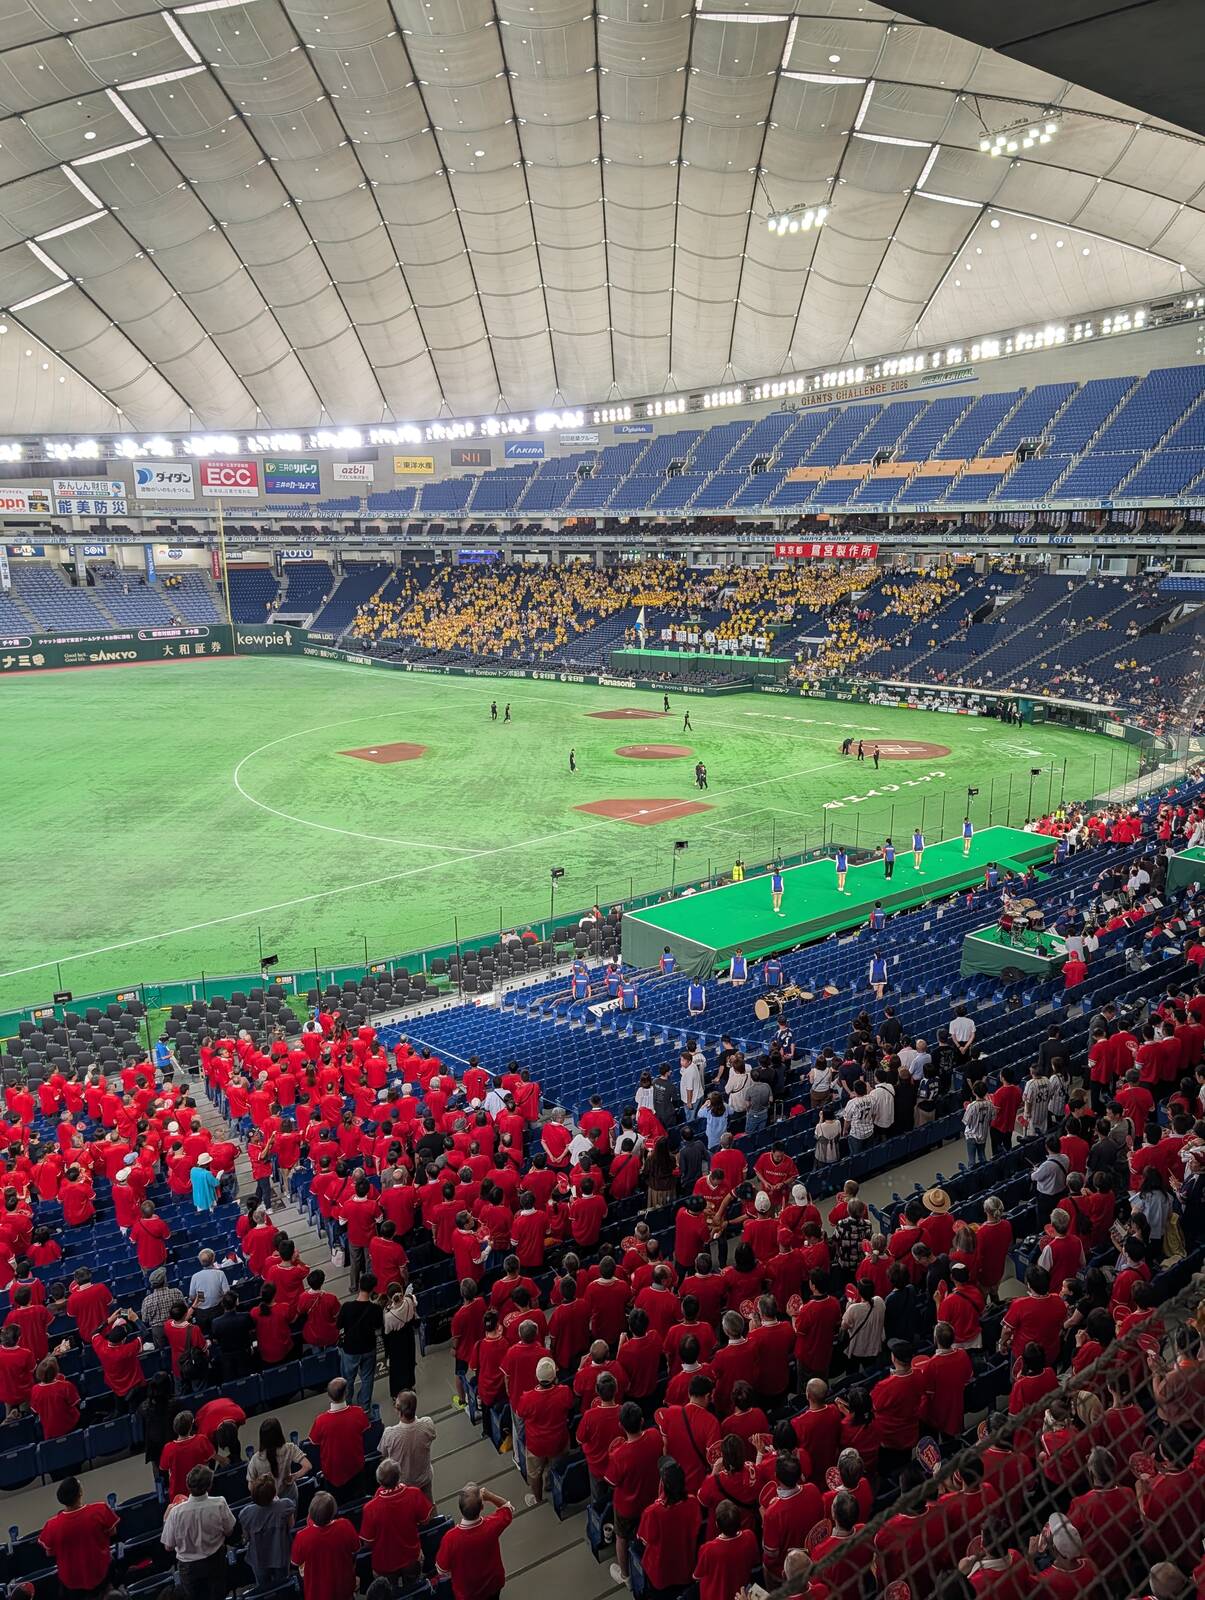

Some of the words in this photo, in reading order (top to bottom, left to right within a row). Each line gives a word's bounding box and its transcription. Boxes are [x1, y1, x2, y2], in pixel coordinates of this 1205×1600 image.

[801, 394, 833, 406] GIANTS
[836, 383, 887, 401] CHALLENGE
[890, 379, 909, 391] 2026
[279, 463, 317, 474] 三井のリパーク
[341, 465, 366, 474] azbil
[156, 471, 191, 483] ダイダン
[207, 467, 251, 485] ECC
[58, 481, 109, 491] あんしん財団
[57, 500, 126, 514] 能美防災
[1093, 535, 1161, 543] 東洋ビルサービス
[281, 550, 312, 558] TOTO
[779, 545, 803, 555] 東京都
[237, 631, 284, 648] kewpie
[163, 641, 222, 657] 大和証券
[89, 649, 138, 662] SANKYO
[598, 677, 636, 689] Panasonic
